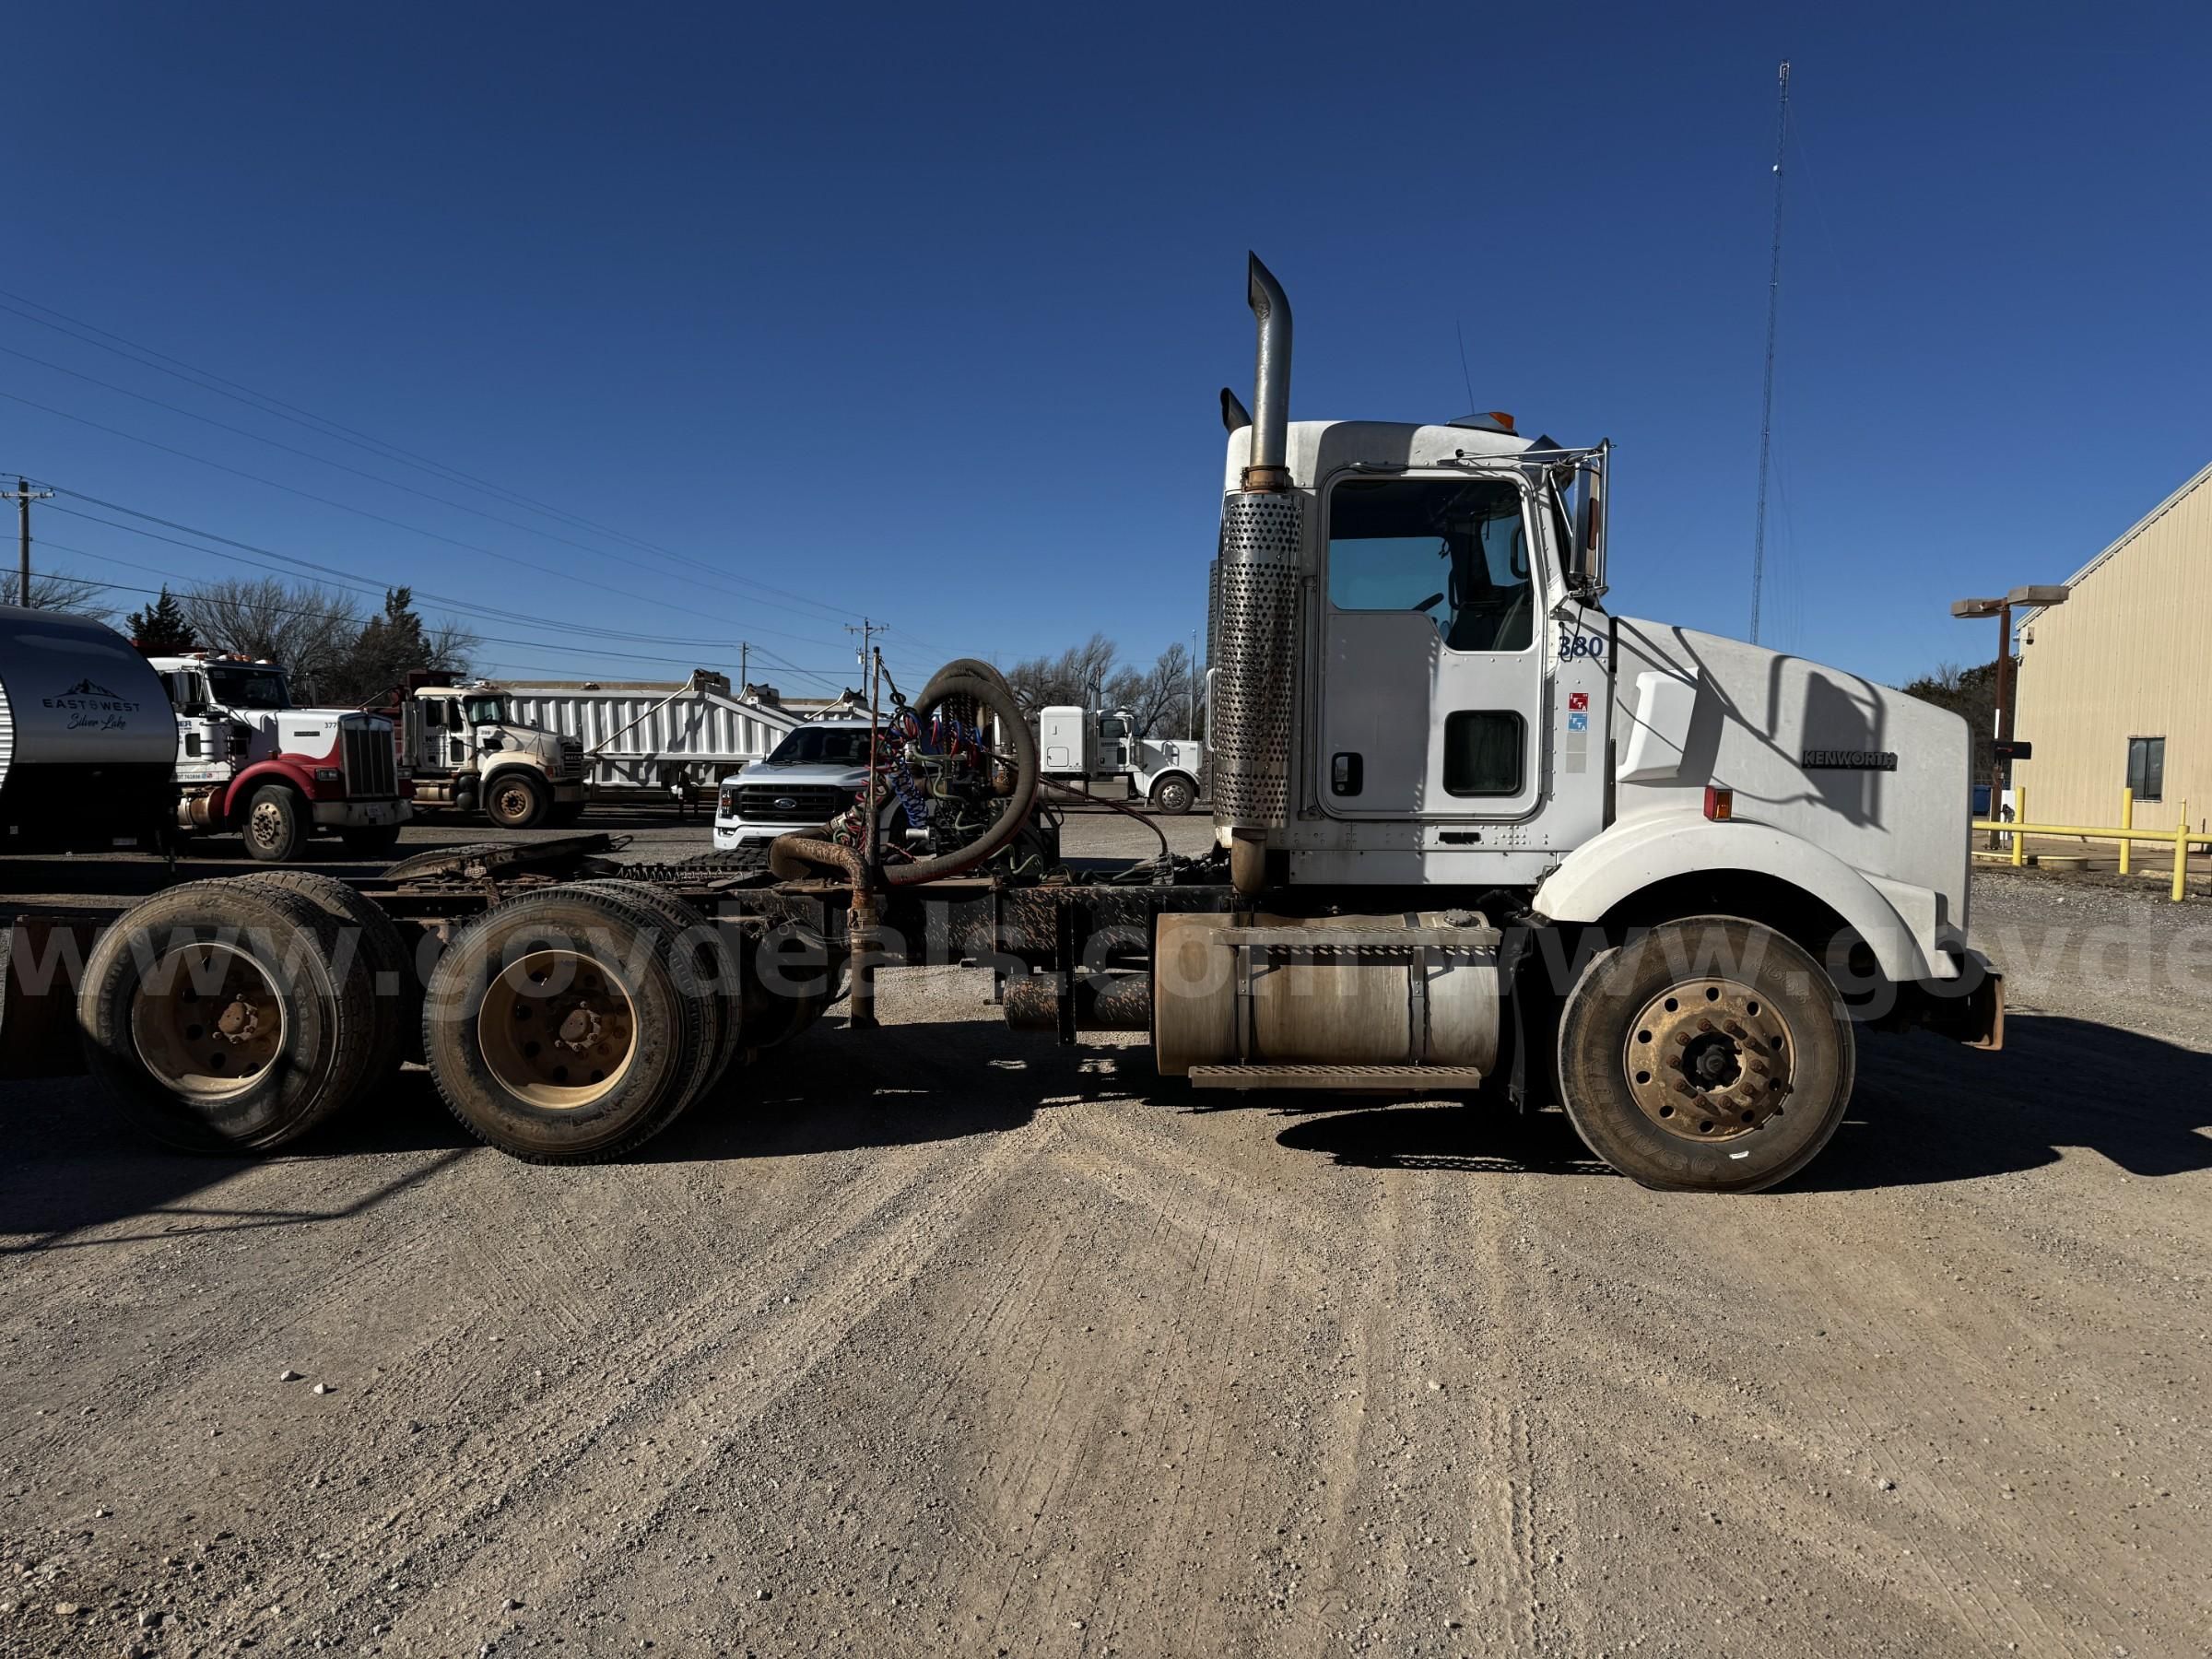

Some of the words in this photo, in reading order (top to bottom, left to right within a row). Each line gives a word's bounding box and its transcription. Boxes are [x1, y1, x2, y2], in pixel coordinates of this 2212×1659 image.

[1559, 636, 1603, 657] 380
[42, 698, 85, 710] EAST
[100, 700, 140, 712] WEST
[66, 712, 99, 730] Silver
[100, 713, 126, 731] Lake
[1803, 751, 1897, 767] KENWORTH
